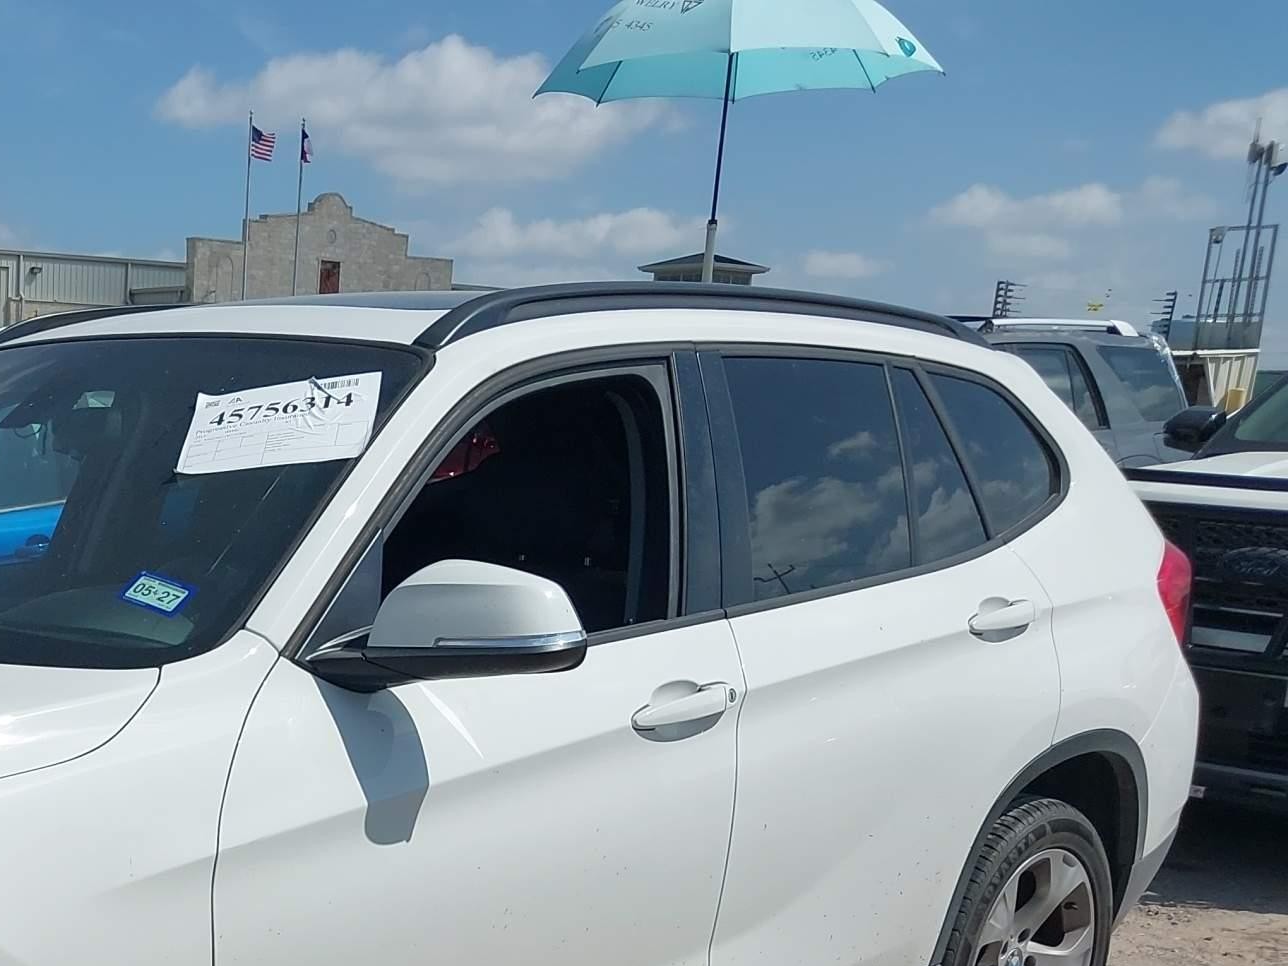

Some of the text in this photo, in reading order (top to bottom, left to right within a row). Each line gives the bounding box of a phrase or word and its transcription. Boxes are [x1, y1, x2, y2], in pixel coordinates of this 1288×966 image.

[209, 391, 354, 426] 45756314
[133, 583, 155, 596] 05
[156, 591, 180, 604] 27
